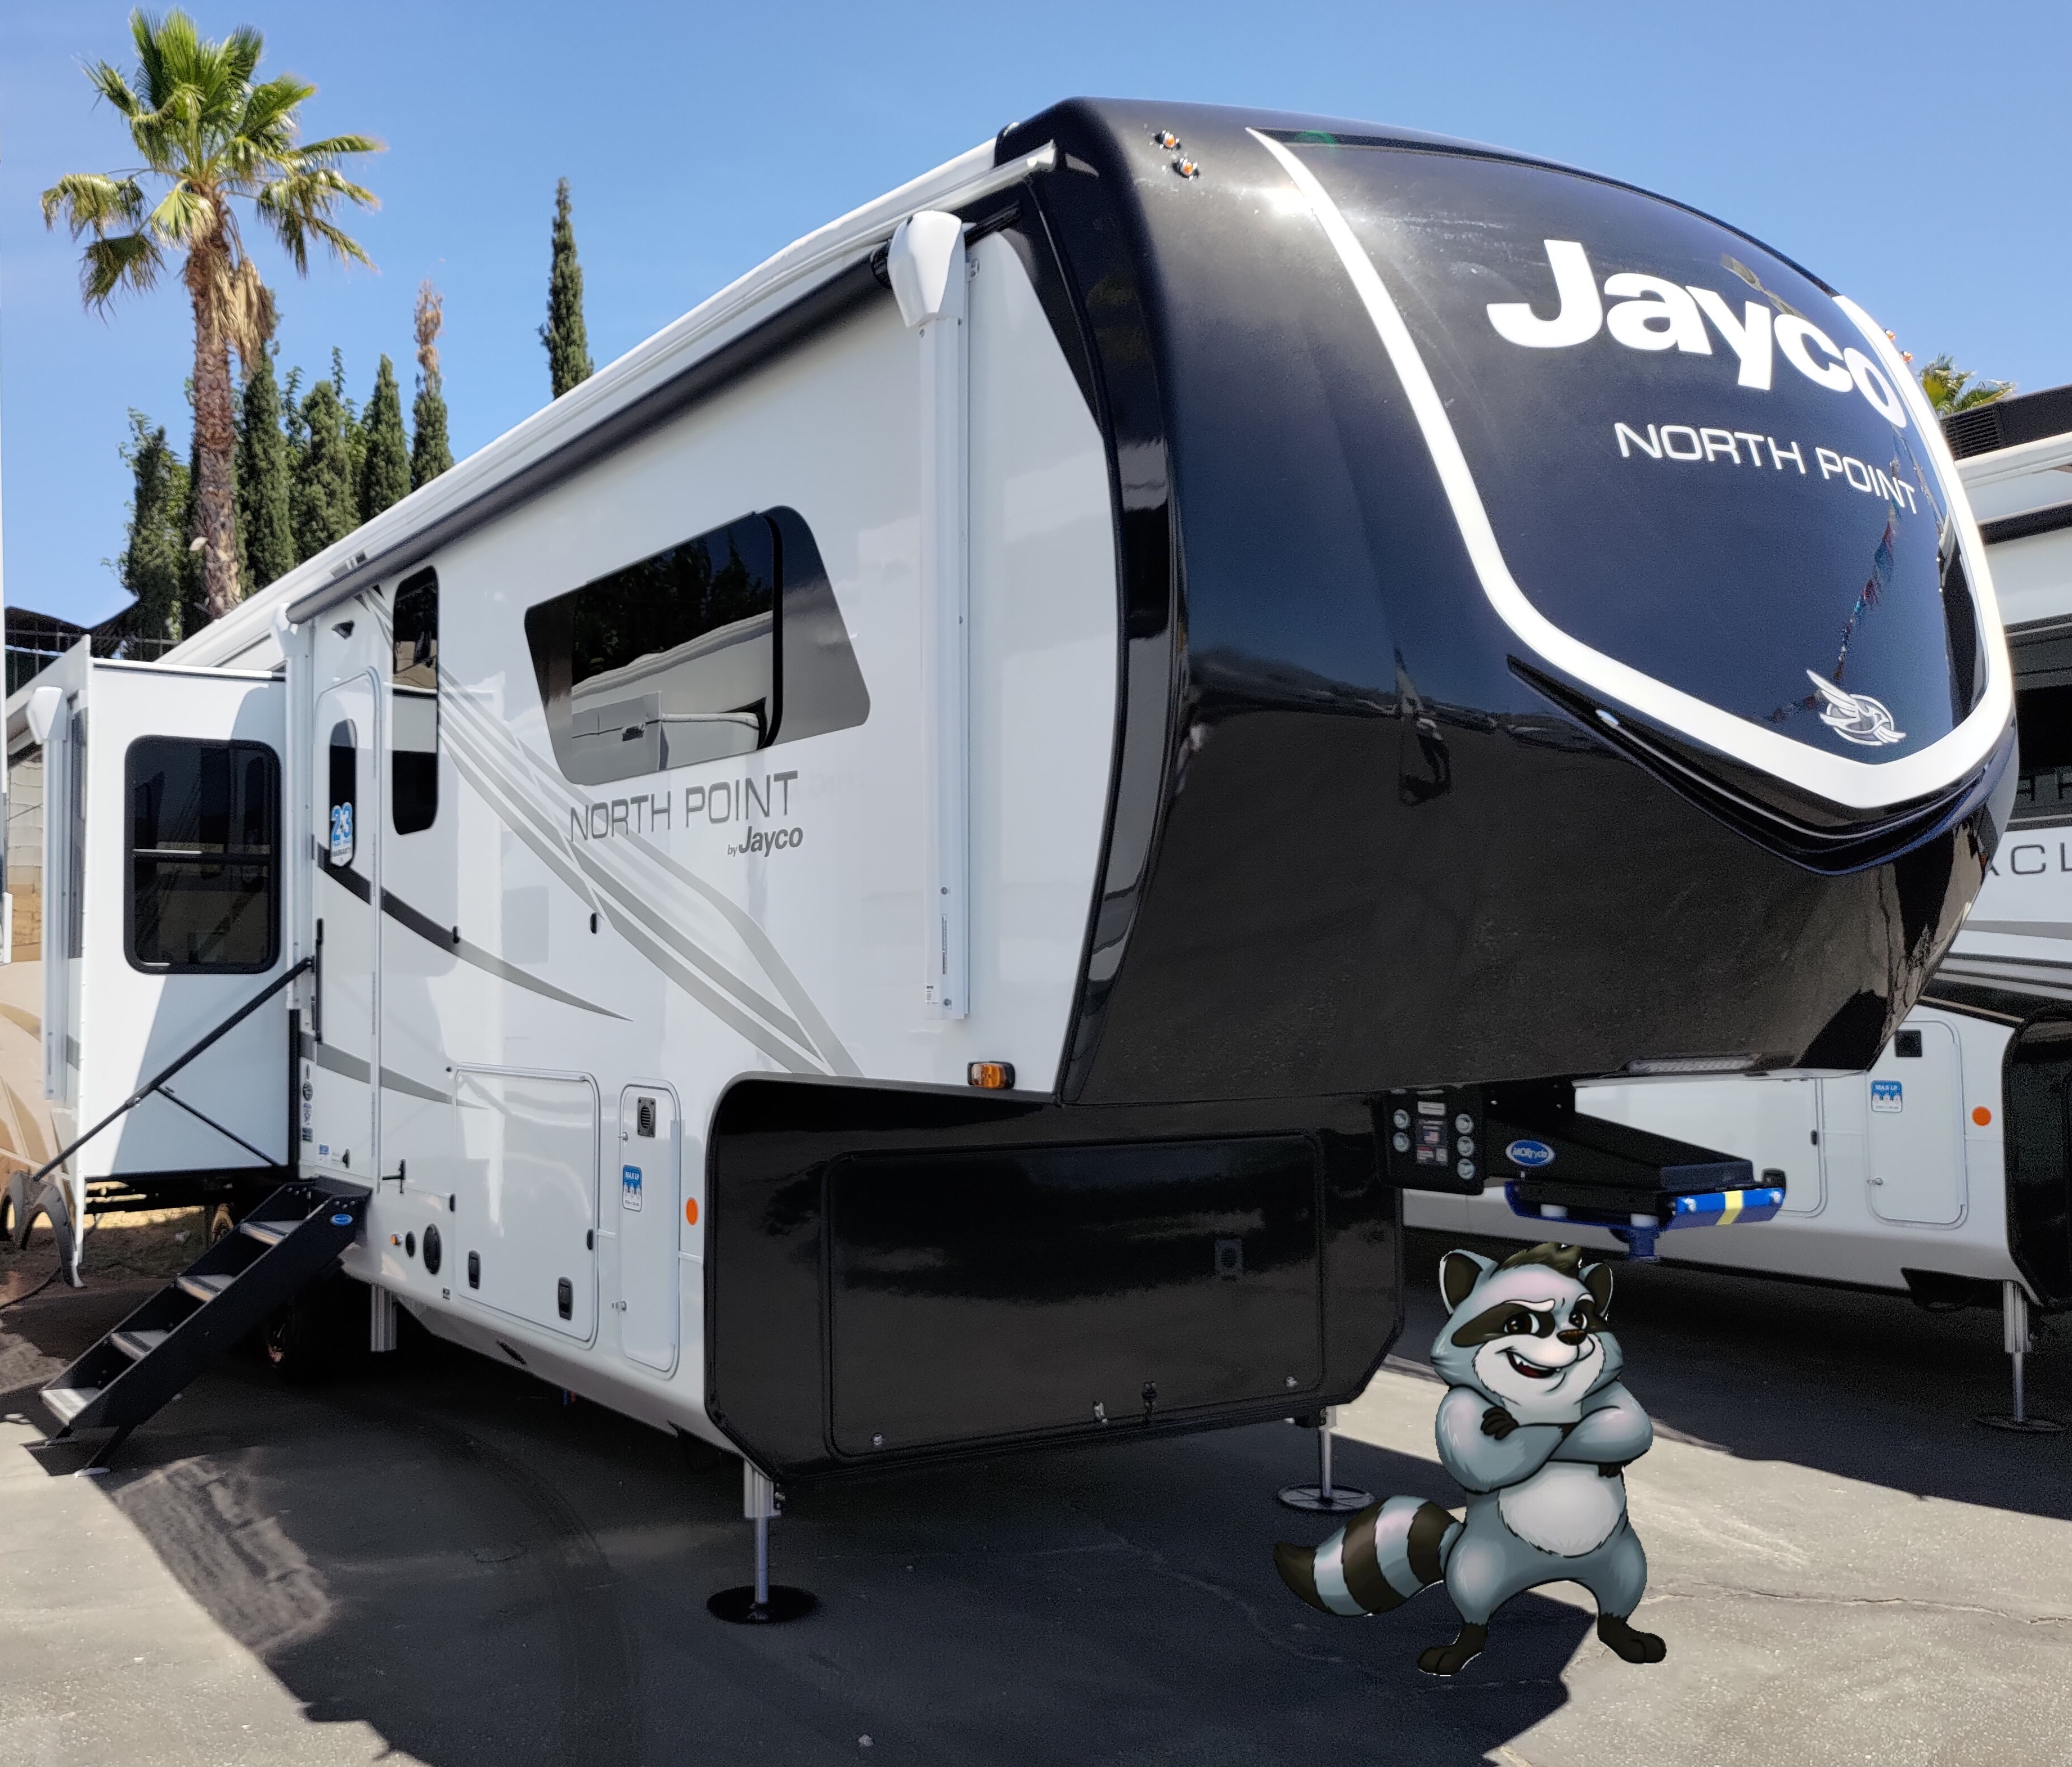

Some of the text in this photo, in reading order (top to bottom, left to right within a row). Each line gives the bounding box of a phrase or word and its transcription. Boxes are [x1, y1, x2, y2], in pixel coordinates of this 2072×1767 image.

[1486, 239, 1907, 429] Jayco
[1614, 422, 1917, 515] NORTH POINT
[570, 770, 798, 842] NORTH POINT
[727, 826, 803, 857] by Jayco
[1990, 842, 2072, 876] CL
